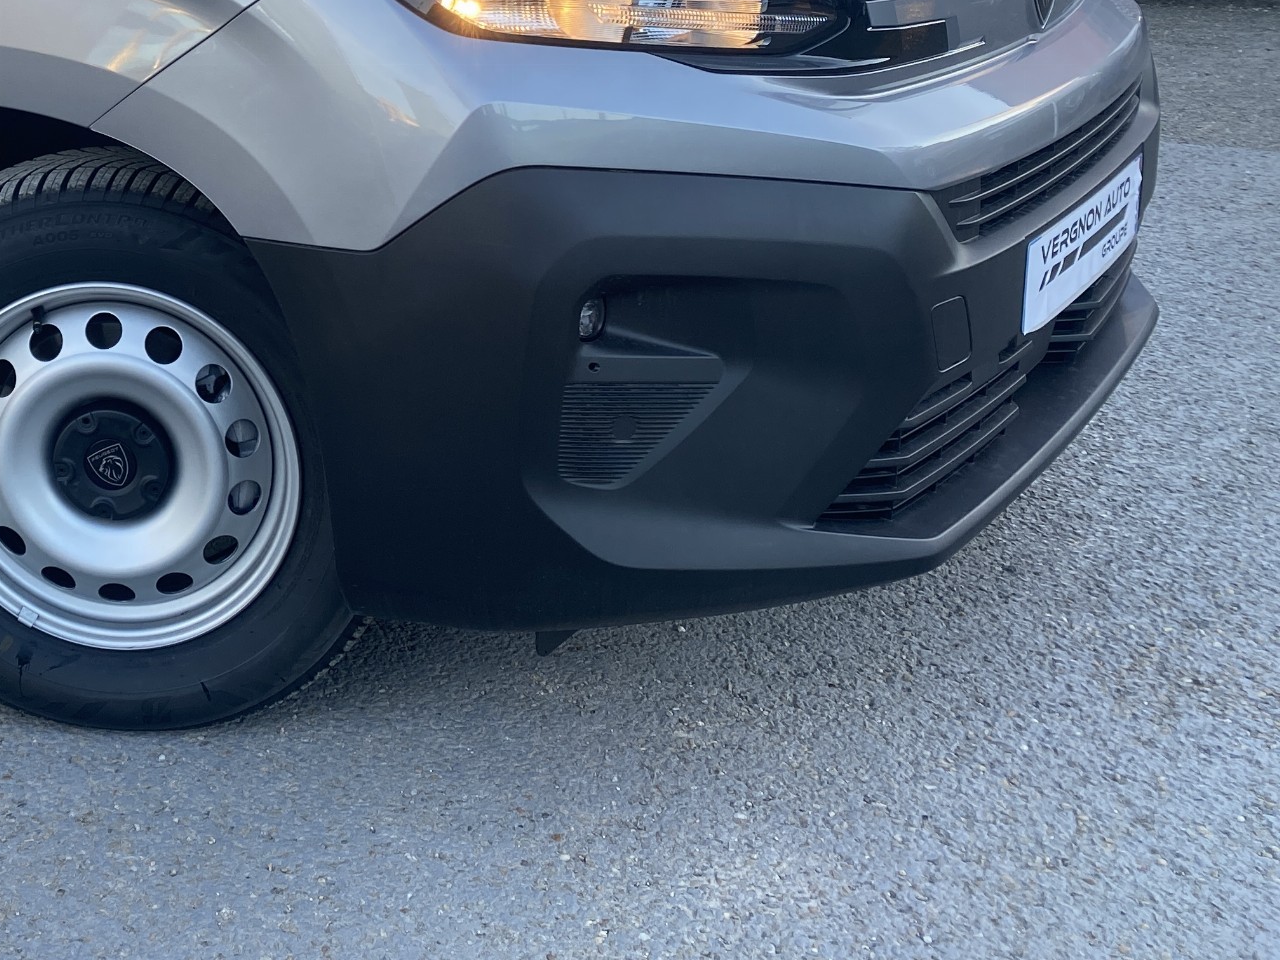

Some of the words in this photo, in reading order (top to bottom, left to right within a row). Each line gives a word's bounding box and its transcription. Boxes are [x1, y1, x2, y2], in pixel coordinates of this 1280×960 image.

[1041, 201, 1103, 265] VERGNON
[1104, 176, 1131, 218] AUTO
[1101, 222, 1129, 258] GROUPE
